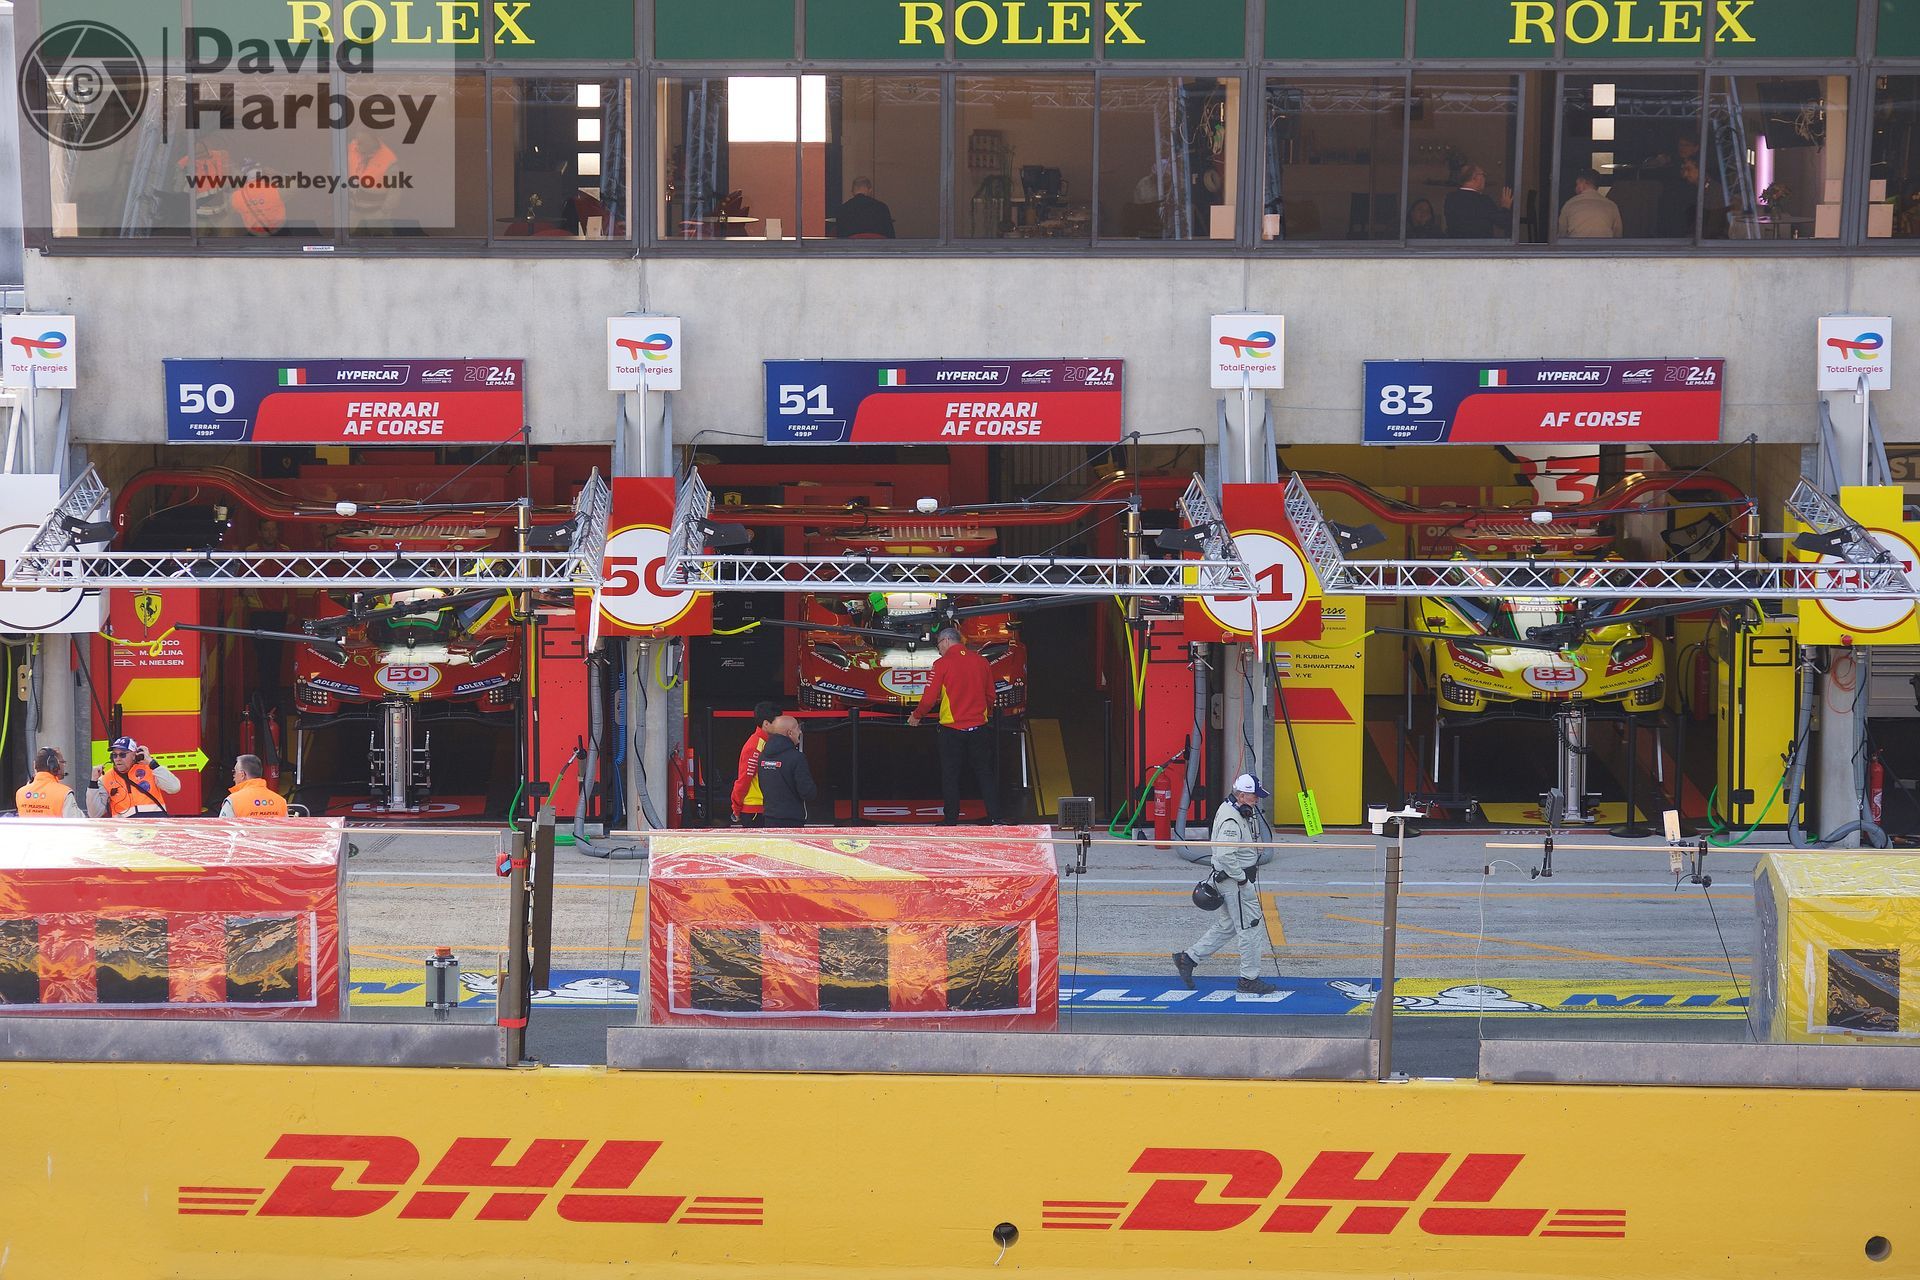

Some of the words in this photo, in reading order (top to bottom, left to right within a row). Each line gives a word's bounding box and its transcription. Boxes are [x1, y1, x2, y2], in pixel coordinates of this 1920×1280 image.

[287, 1, 535, 44] ROLEX
[899, 0, 1146, 45] ROLEX
[1508, 0, 1756, 43] ROLEX
[11, 364, 68, 373] TotaEnergies
[337, 370, 399, 380] HYPERCAR
[616, 366, 673, 375] TotalEergies
[936, 370, 999, 381] HYPERCAR
[1219, 364, 1277, 373] TotalEnergies
[1826, 365, 1884, 374] TotalEnergies
[1537, 371, 1600, 381] HYPERCAR
[179, 384, 235, 413] 50
[779, 384, 834, 414] 51
[1379, 385, 1433, 415] 83
[347, 402, 439, 418] FERRARI
[945, 402, 1038, 418] FERRARI
[1540, 412, 1570, 427] AF
[1574, 411, 1642, 427] CORSE
[343, 421, 373, 435] AF
[377, 420, 444, 435] CORSE
[941, 421, 970, 435] AF
[975, 420, 1042, 435] CORSE
[600, 556, 688, 598] 50
[1458, 655, 1483, 668] ORLEN
[390, 668, 427, 680] 50
[894, 671, 929, 683] 51
[1536, 666, 1574, 679] 83
[313, 678, 342, 688] ADLER
[457, 681, 485, 691] ADLER
[818, 682, 847, 692] ADLER
[257, 1133, 687, 1223] DHL
[1120, 1148, 1549, 1237] DHL
